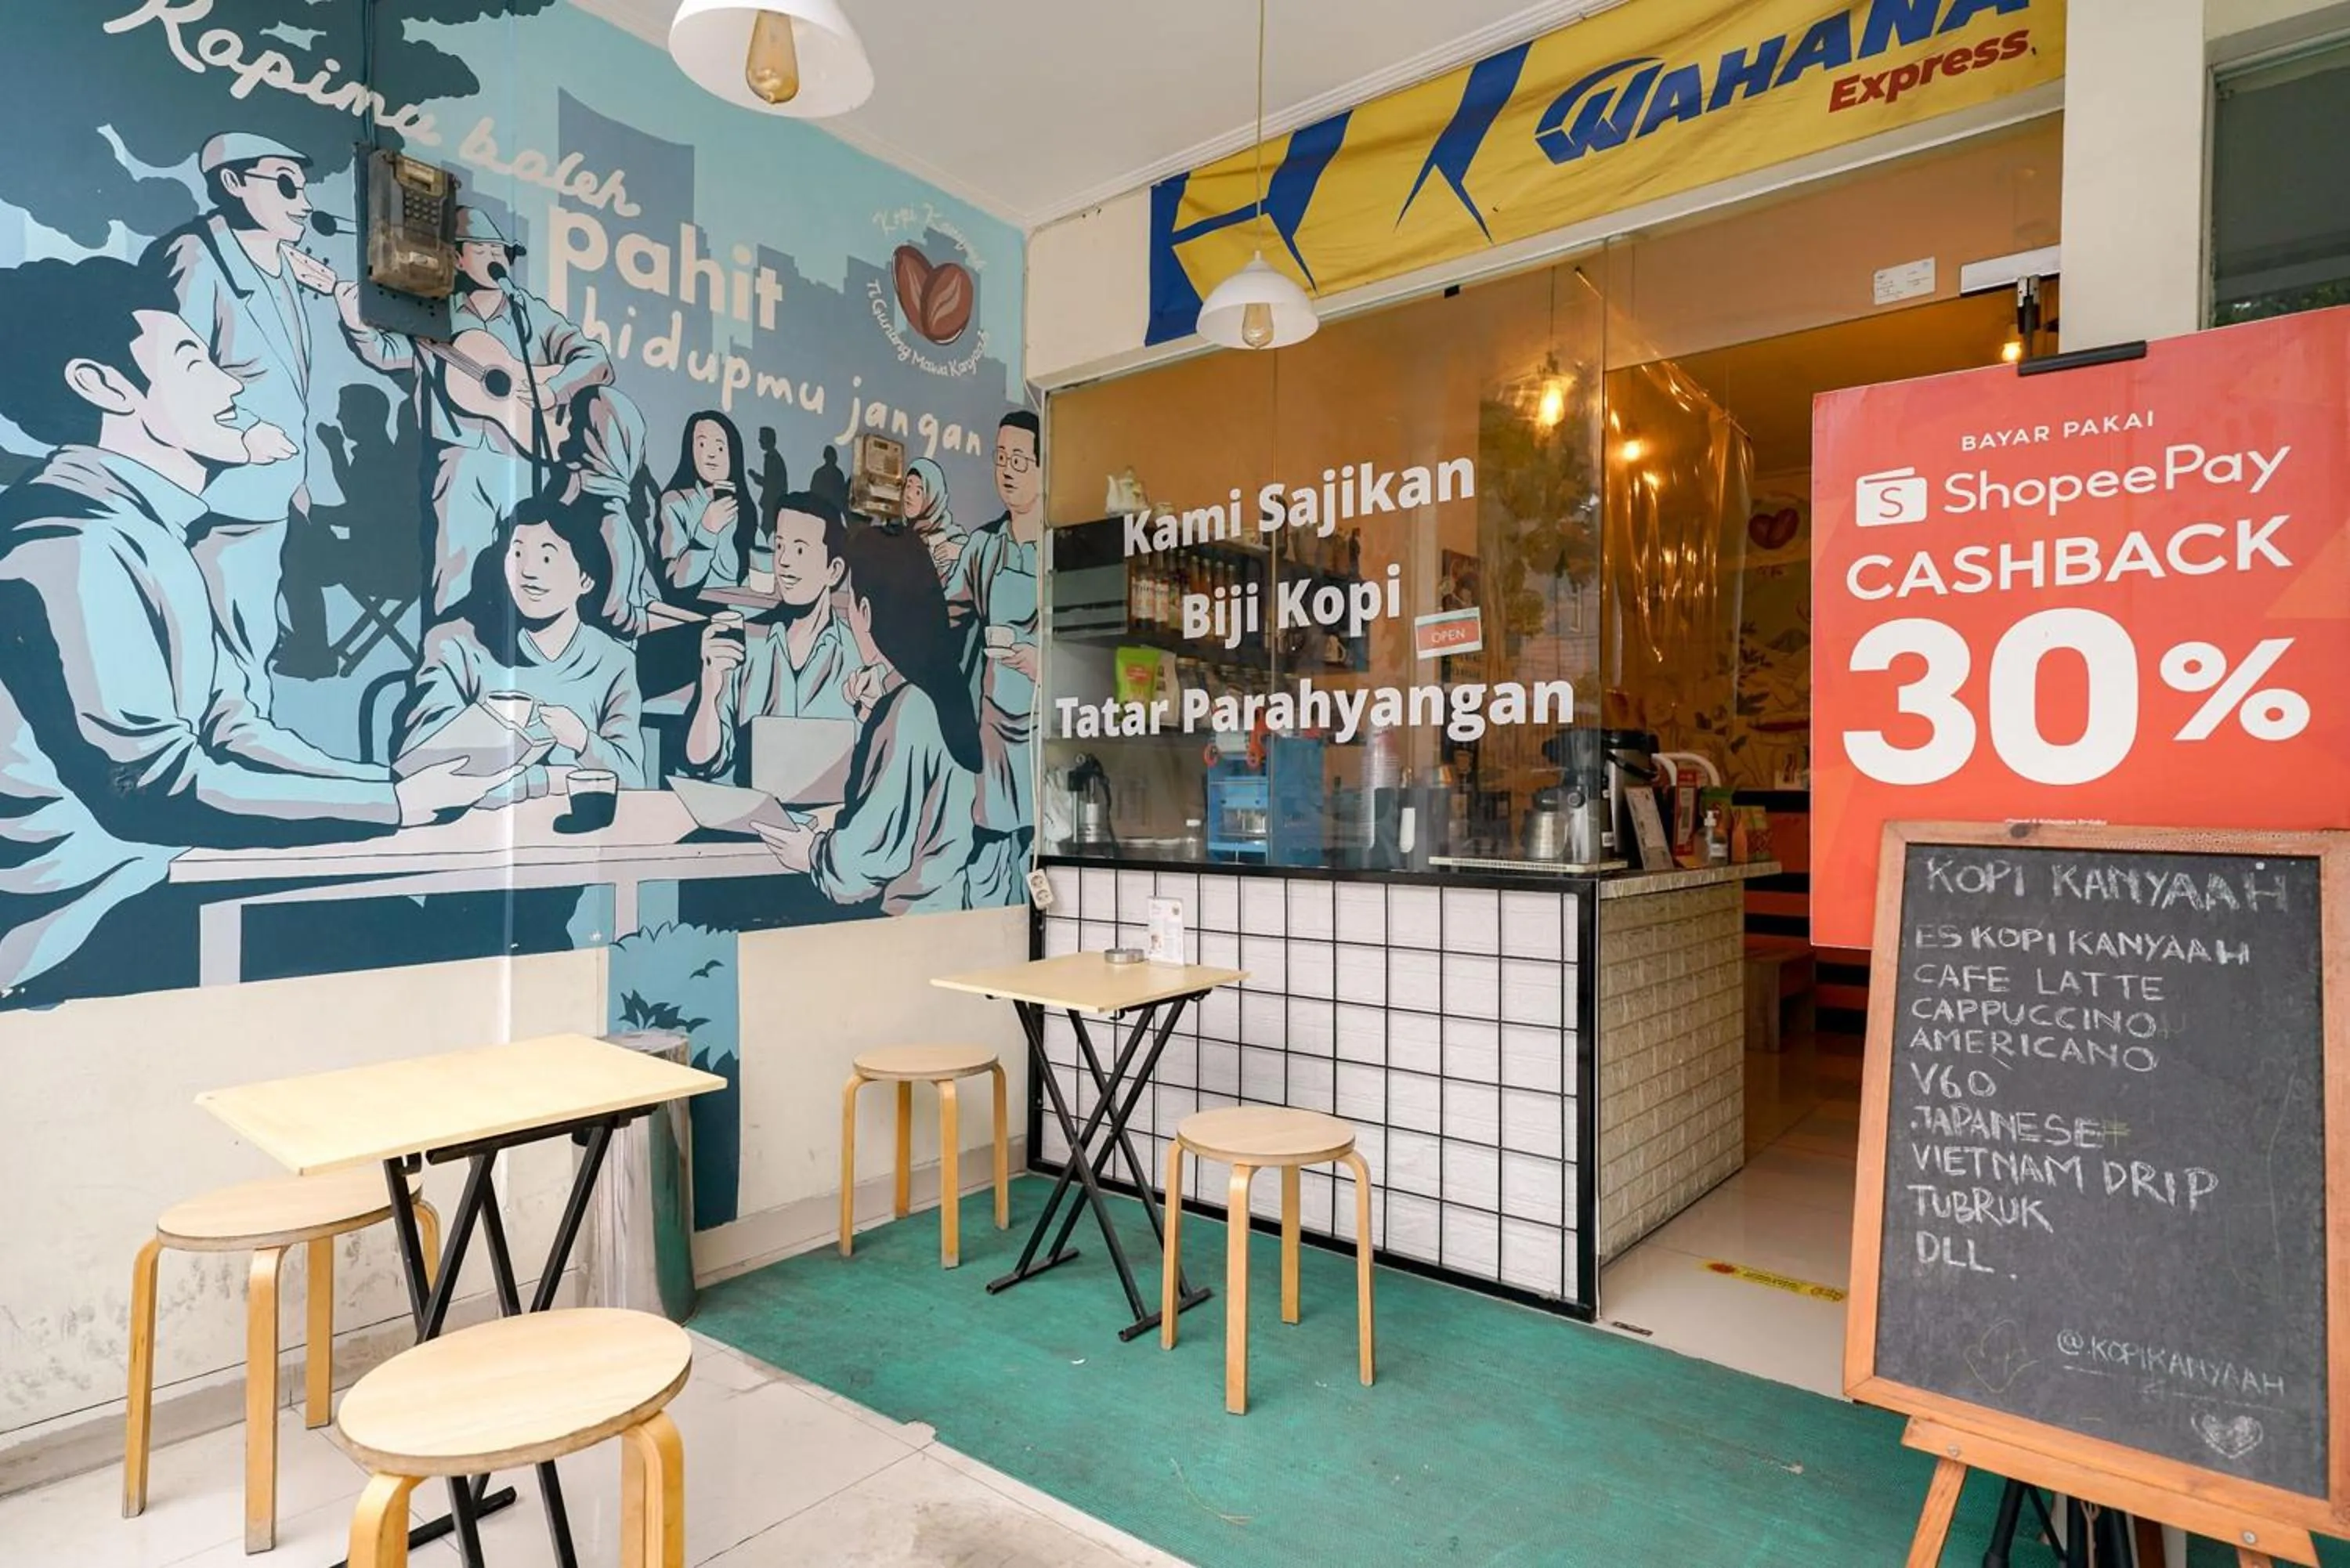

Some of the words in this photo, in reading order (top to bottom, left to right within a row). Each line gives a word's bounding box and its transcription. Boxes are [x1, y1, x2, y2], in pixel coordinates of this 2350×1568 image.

[1828, 29, 2030, 113] Express
[459, 116, 641, 218] boleh
[548, 205, 783, 331] pahit
[581, 287, 825, 414] hidupmu
[834, 375, 982, 457] jangan
[872, 298, 912, 361] Gunung
[911, 350, 949, 376] Mawa
[1961, 425, 2051, 452] BAYAR
[2063, 410, 2155, 438] PAKAI
[1123, 489, 1242, 558] Kami
[1258, 457, 1476, 538] Sajikan
[1943, 443, 2292, 516] ShopeePay
[1846, 515, 2294, 601] CASHBACK
[1182, 575, 1259, 649] Biji
[1277, 563, 1401, 638] Kopi
[1430, 627, 1466, 644] OPEN
[1055, 692, 1169, 739] Tatar
[1183, 677, 1575, 743] Parahyangan
[1842, 607, 2311, 786] 30%
[1927, 857, 2025, 898] KOPI
[2051, 864, 2288, 913] KANYAAH
[1914, 924, 1963, 951] ES
[1970, 926, 2057, 956] KOPI
[2067, 929, 2251, 966] KANYAAH
[1911, 996, 2157, 1039] CAPPUCCINO
[1913, 963, 2011, 993] CAFE
[2036, 966, 2166, 1002] LATTE
[1909, 1026, 2159, 1072] AMERICANO
[1910, 1061, 1998, 1099] V60
[1906, 1183, 2054, 1234] TUBRUK
[1911, 1143, 2084, 1194] VIETNAM
[2102, 1158, 2219, 1215] DRIP
